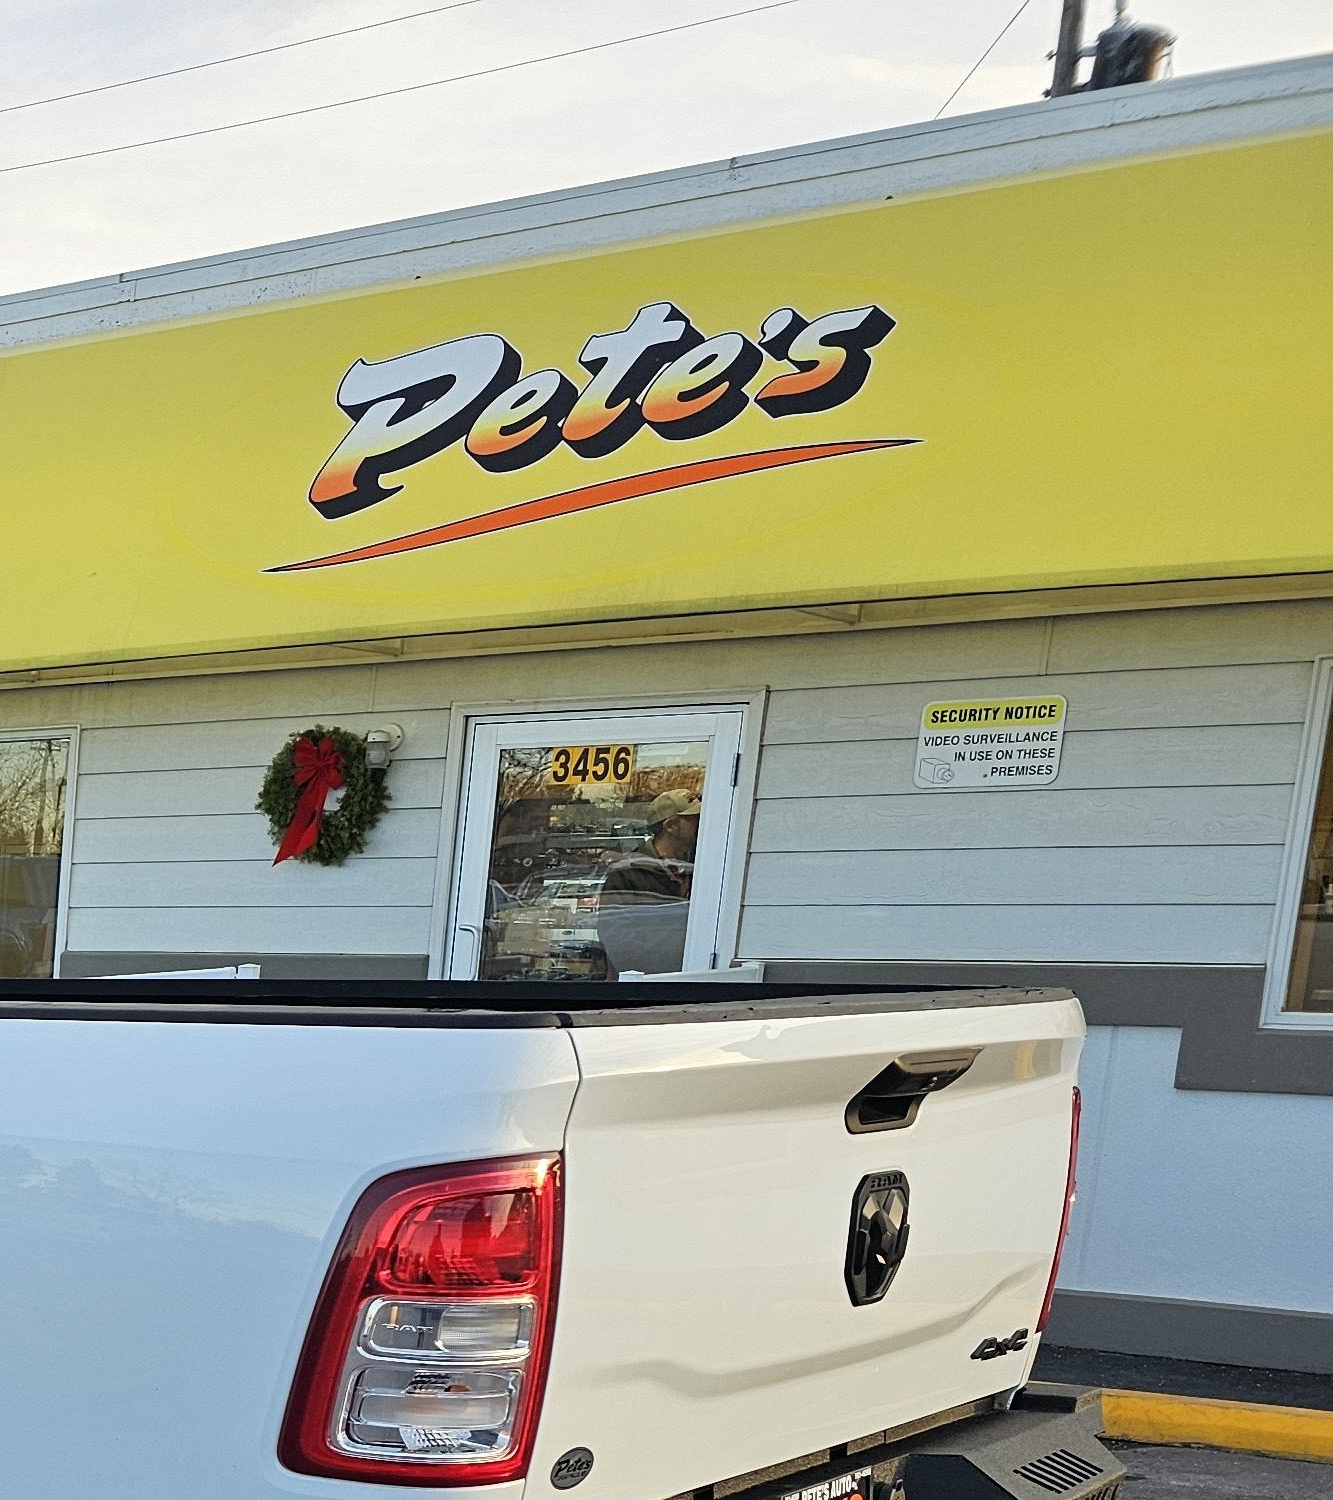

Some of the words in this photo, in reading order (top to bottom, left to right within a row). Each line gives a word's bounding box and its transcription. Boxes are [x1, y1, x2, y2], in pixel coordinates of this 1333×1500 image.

[308, 302, 895, 519] Pete's
[931, 707, 1000, 723] SECURITY
[1004, 705, 1057, 720] NOTICE
[924, 735, 960, 747] VIDEO
[963, 731, 1058, 746] SURVEILLANCE
[954, 751, 966, 762] IN
[969, 750, 993, 762] USE
[996, 749, 1013, 760] ON
[1017, 748, 1055, 760] THESE
[553, 747, 631, 782] 3456
[990, 764, 1053, 777] PREMISES
[870, 1173, 903, 1189] RAM
[830, 1474, 852, 1499] AUTO
